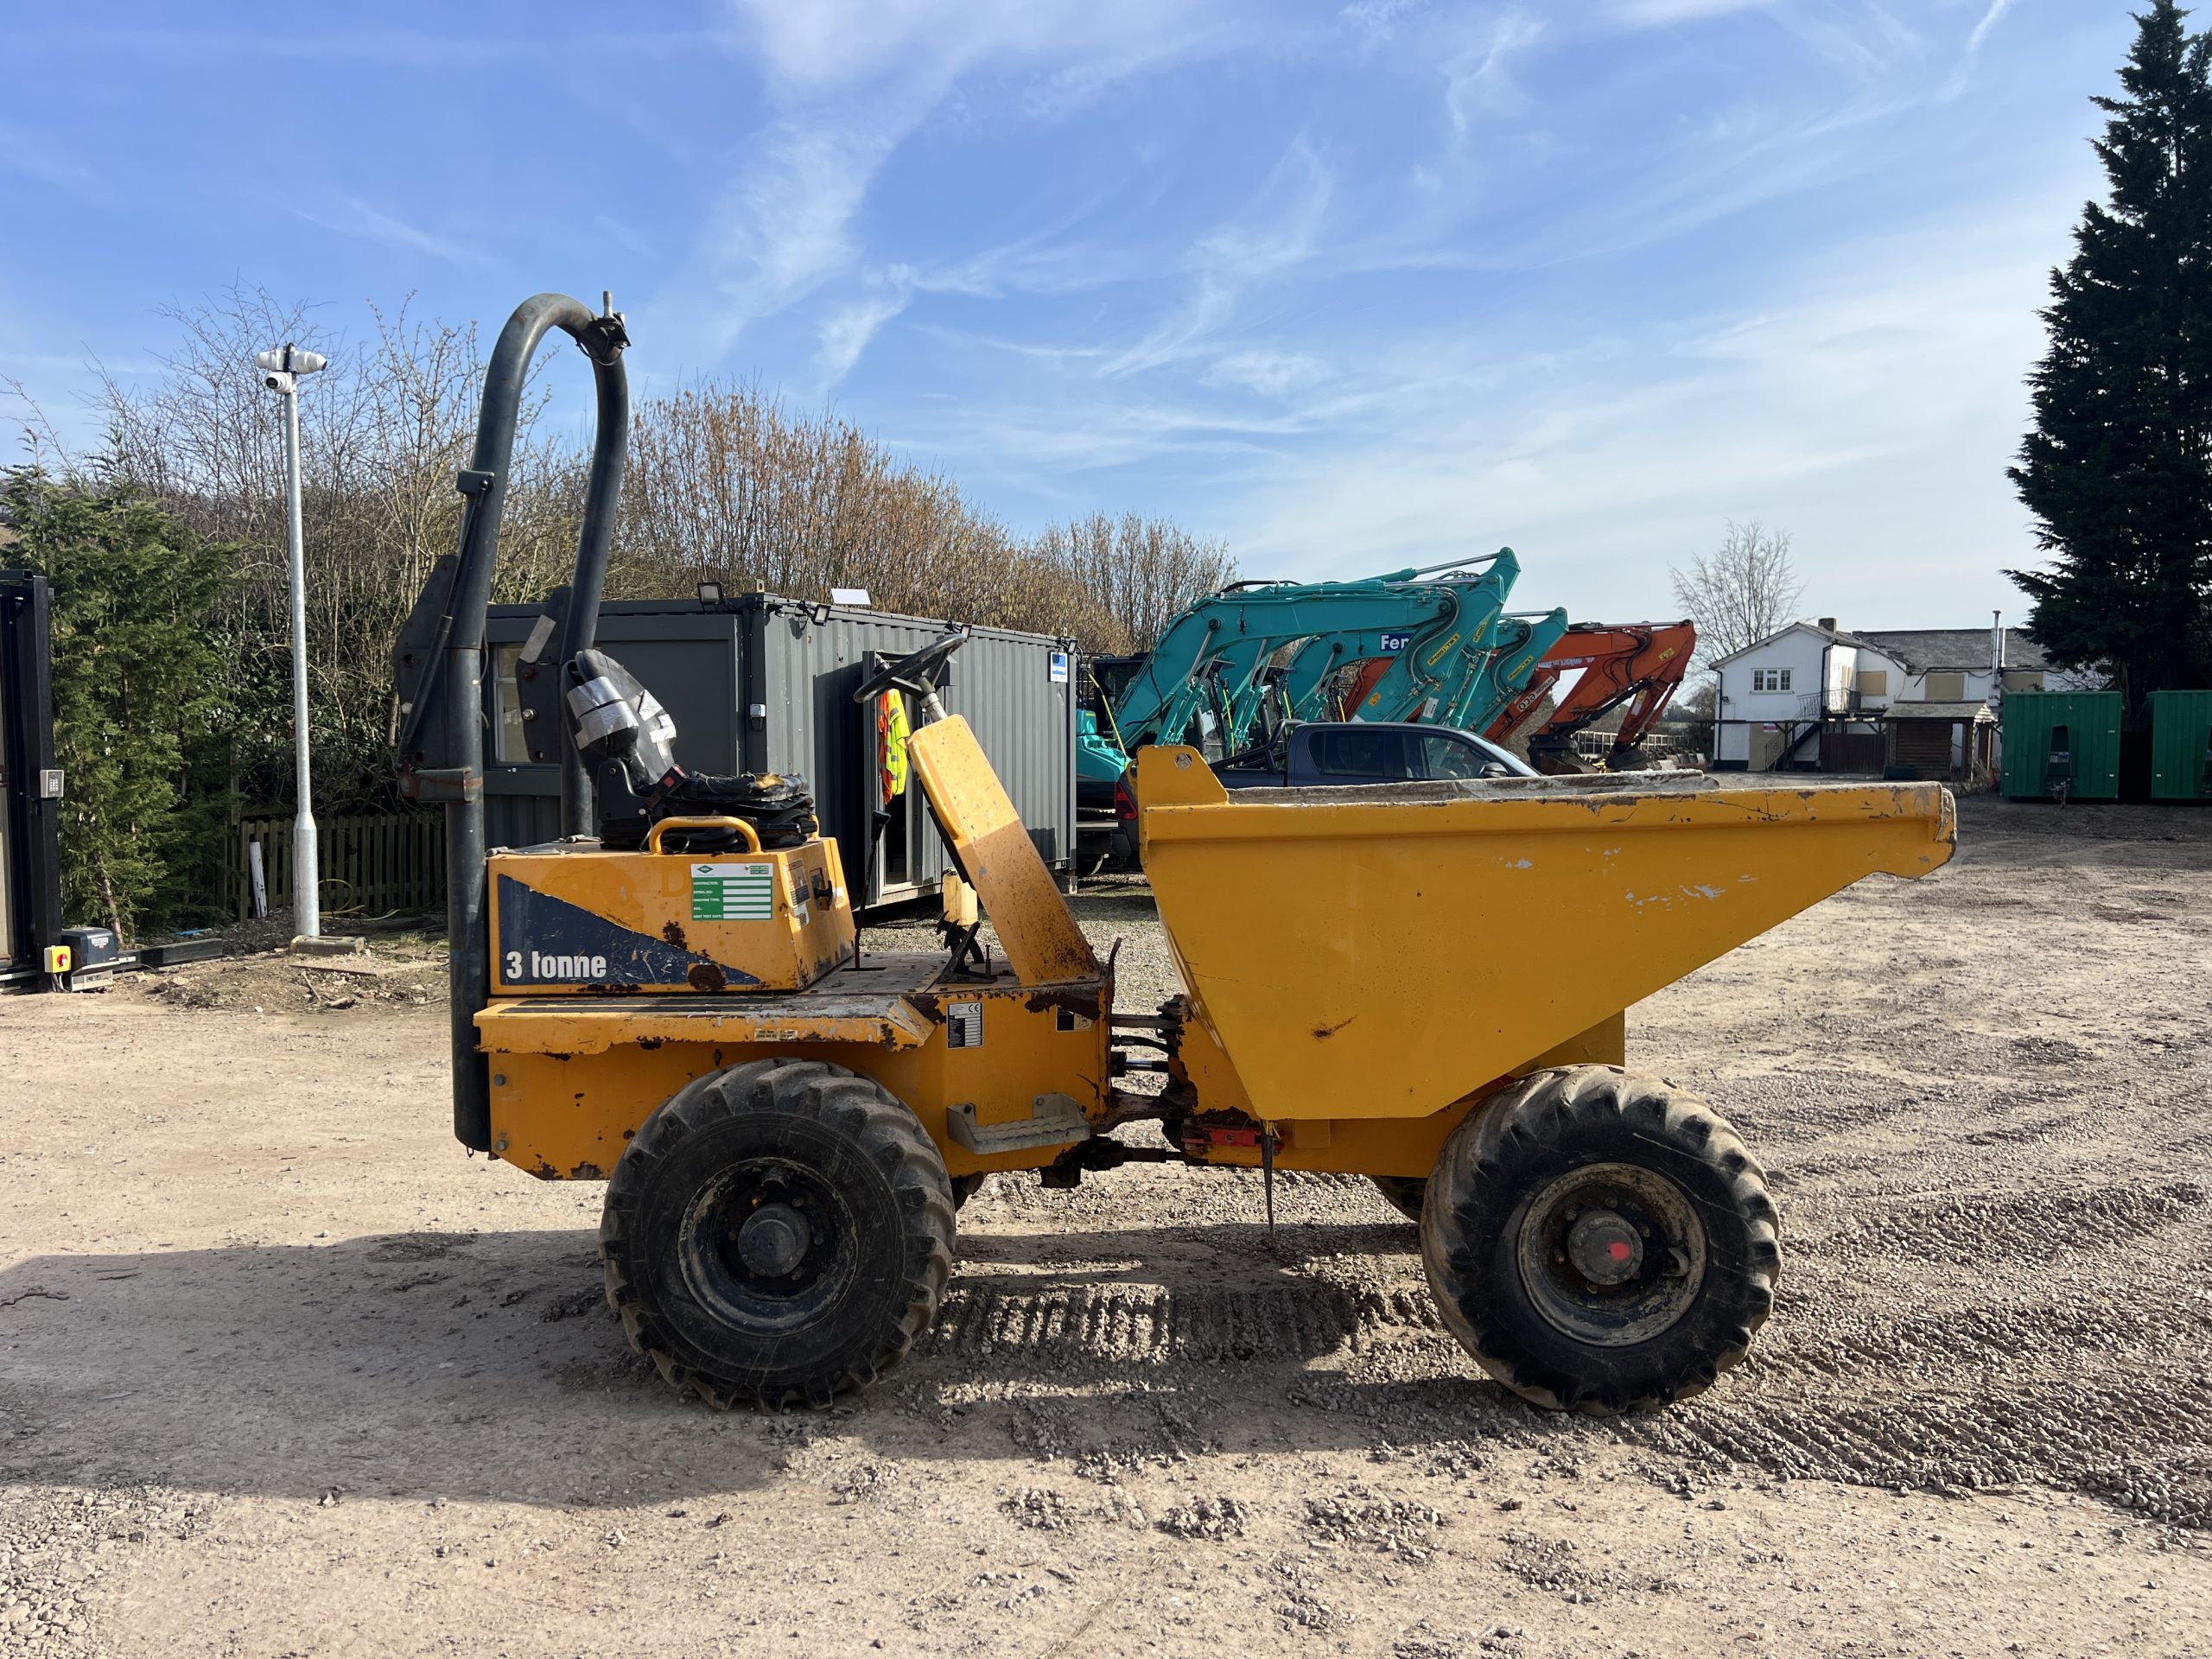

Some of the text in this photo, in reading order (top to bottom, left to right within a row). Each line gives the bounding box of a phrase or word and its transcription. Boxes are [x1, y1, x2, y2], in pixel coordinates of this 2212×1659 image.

[1517, 692, 1535, 710] eco
[506, 950, 607, 979] 3 tonne
